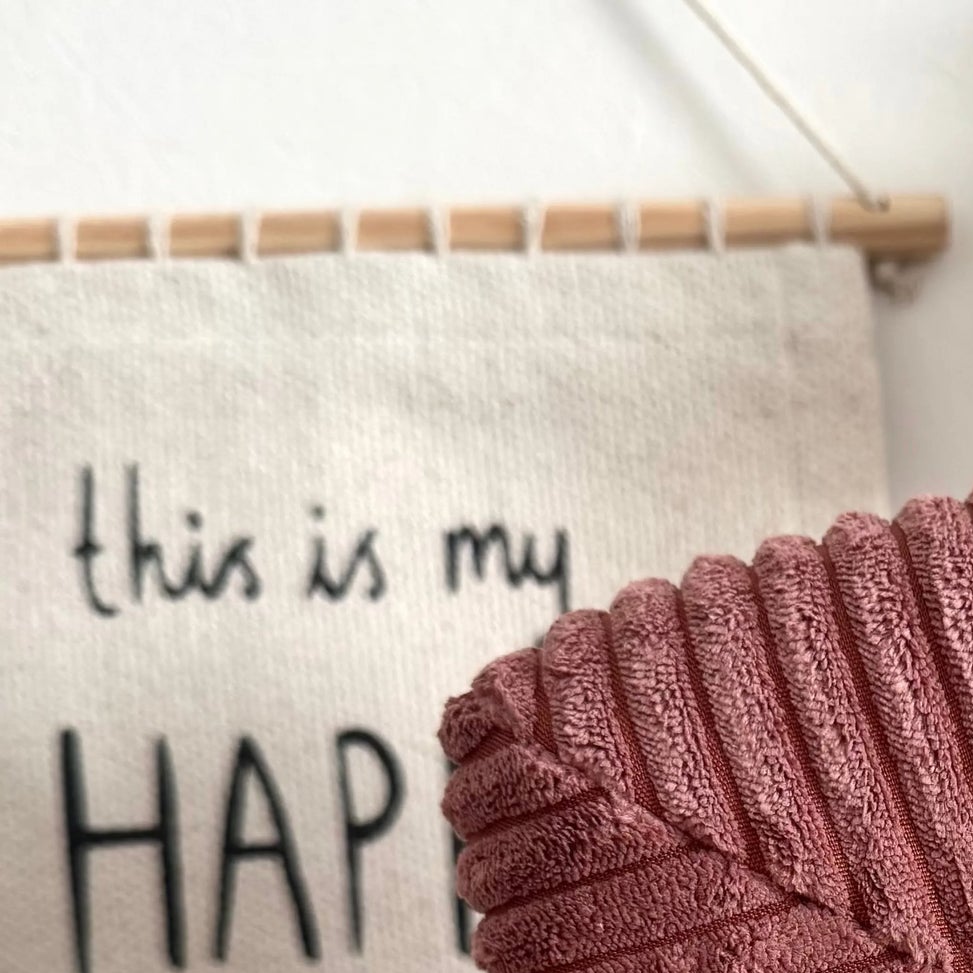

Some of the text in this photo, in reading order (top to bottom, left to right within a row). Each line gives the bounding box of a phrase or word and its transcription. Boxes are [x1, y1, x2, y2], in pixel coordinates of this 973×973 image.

[72, 465, 572, 645] this is my
